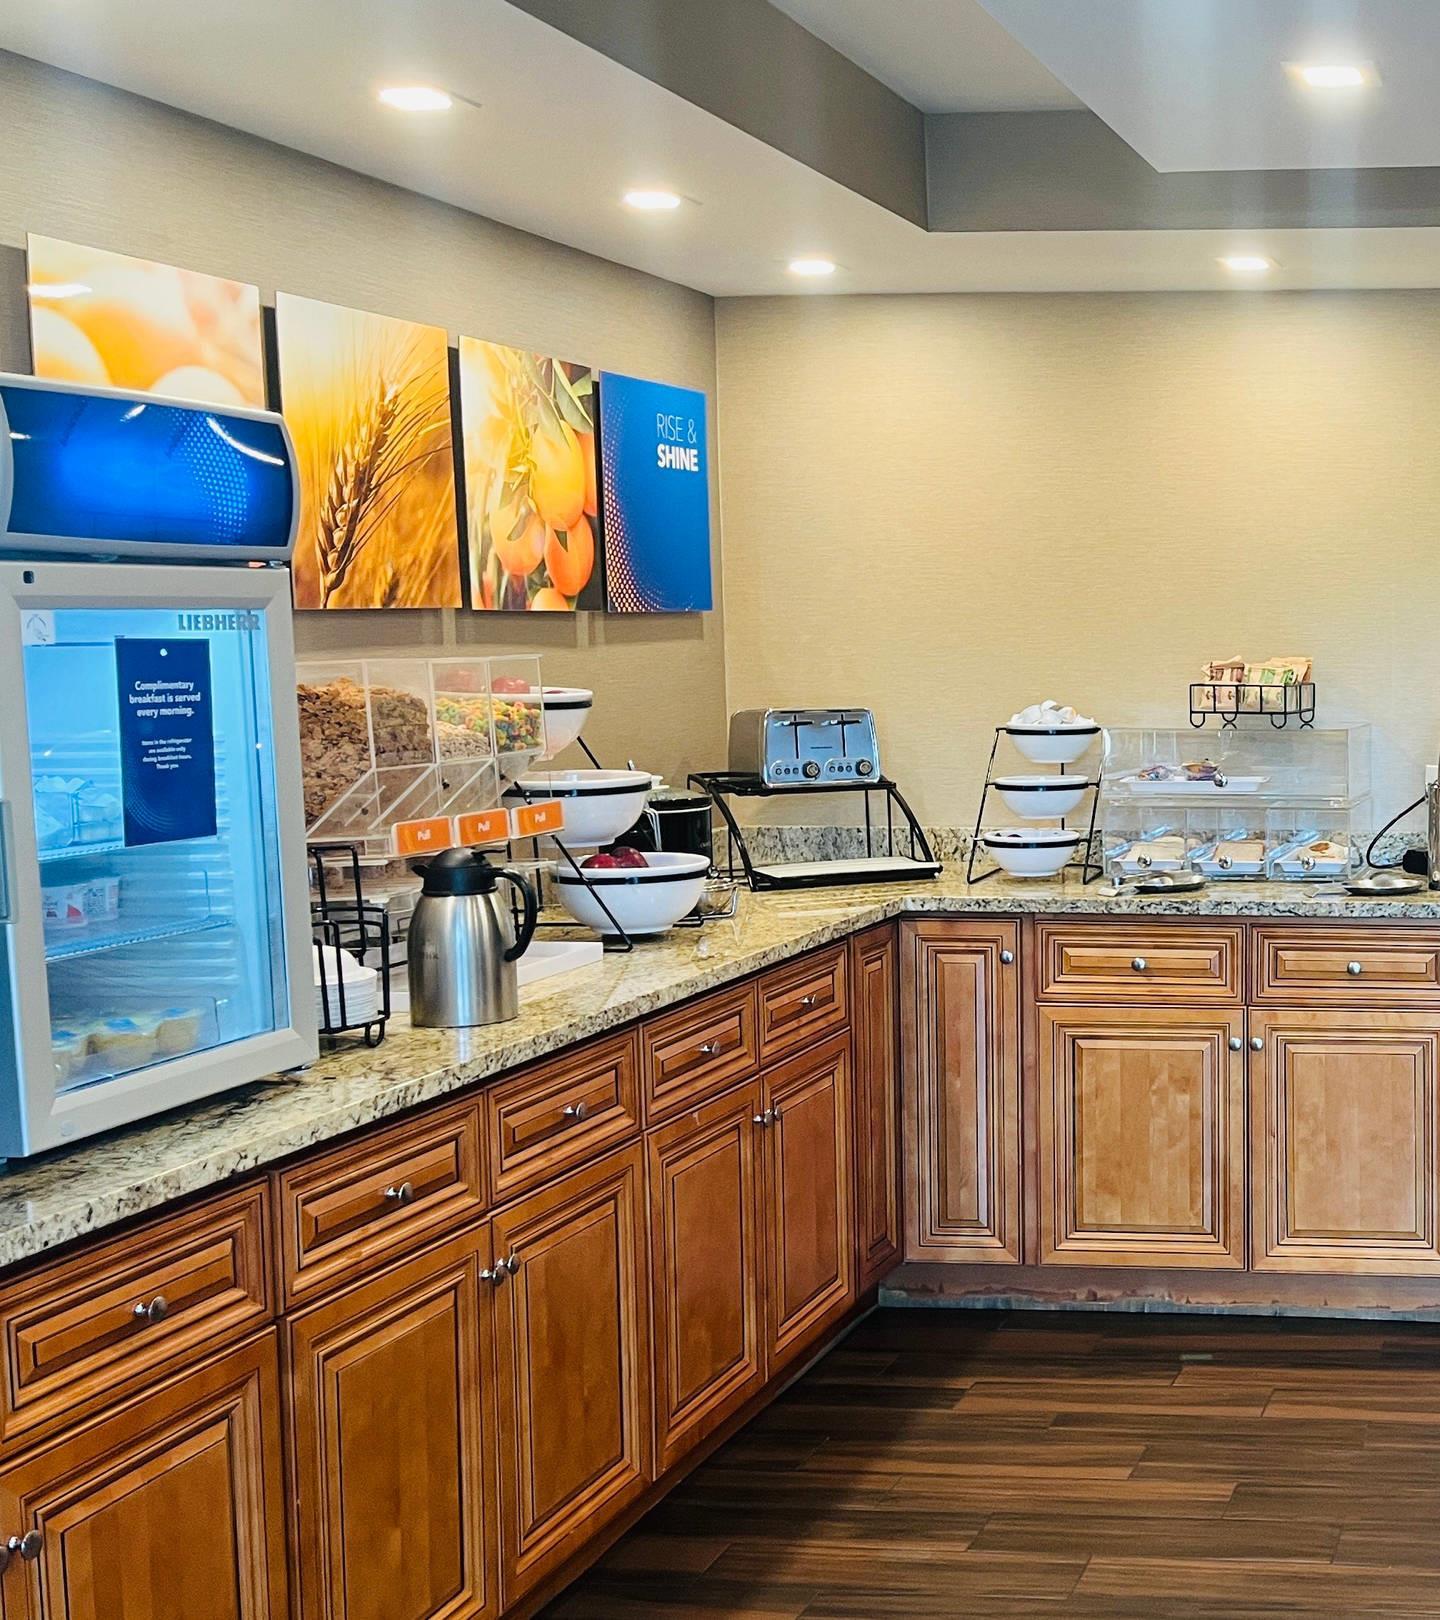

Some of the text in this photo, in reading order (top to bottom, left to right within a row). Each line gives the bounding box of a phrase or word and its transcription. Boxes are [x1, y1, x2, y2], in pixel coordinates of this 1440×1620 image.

[656, 413, 697, 444] RISE &
[657, 443, 699, 472] SHINE
[178, 614, 261, 631] LIEBHERR
[134, 680, 195, 692] Complimentary
[128, 691, 202, 704] breakfast is served
[136, 705, 195, 719] every morning.
[534, 811, 546, 823] Pull
[477, 821, 491, 833] Pull
[417, 830, 431, 841] Pull
